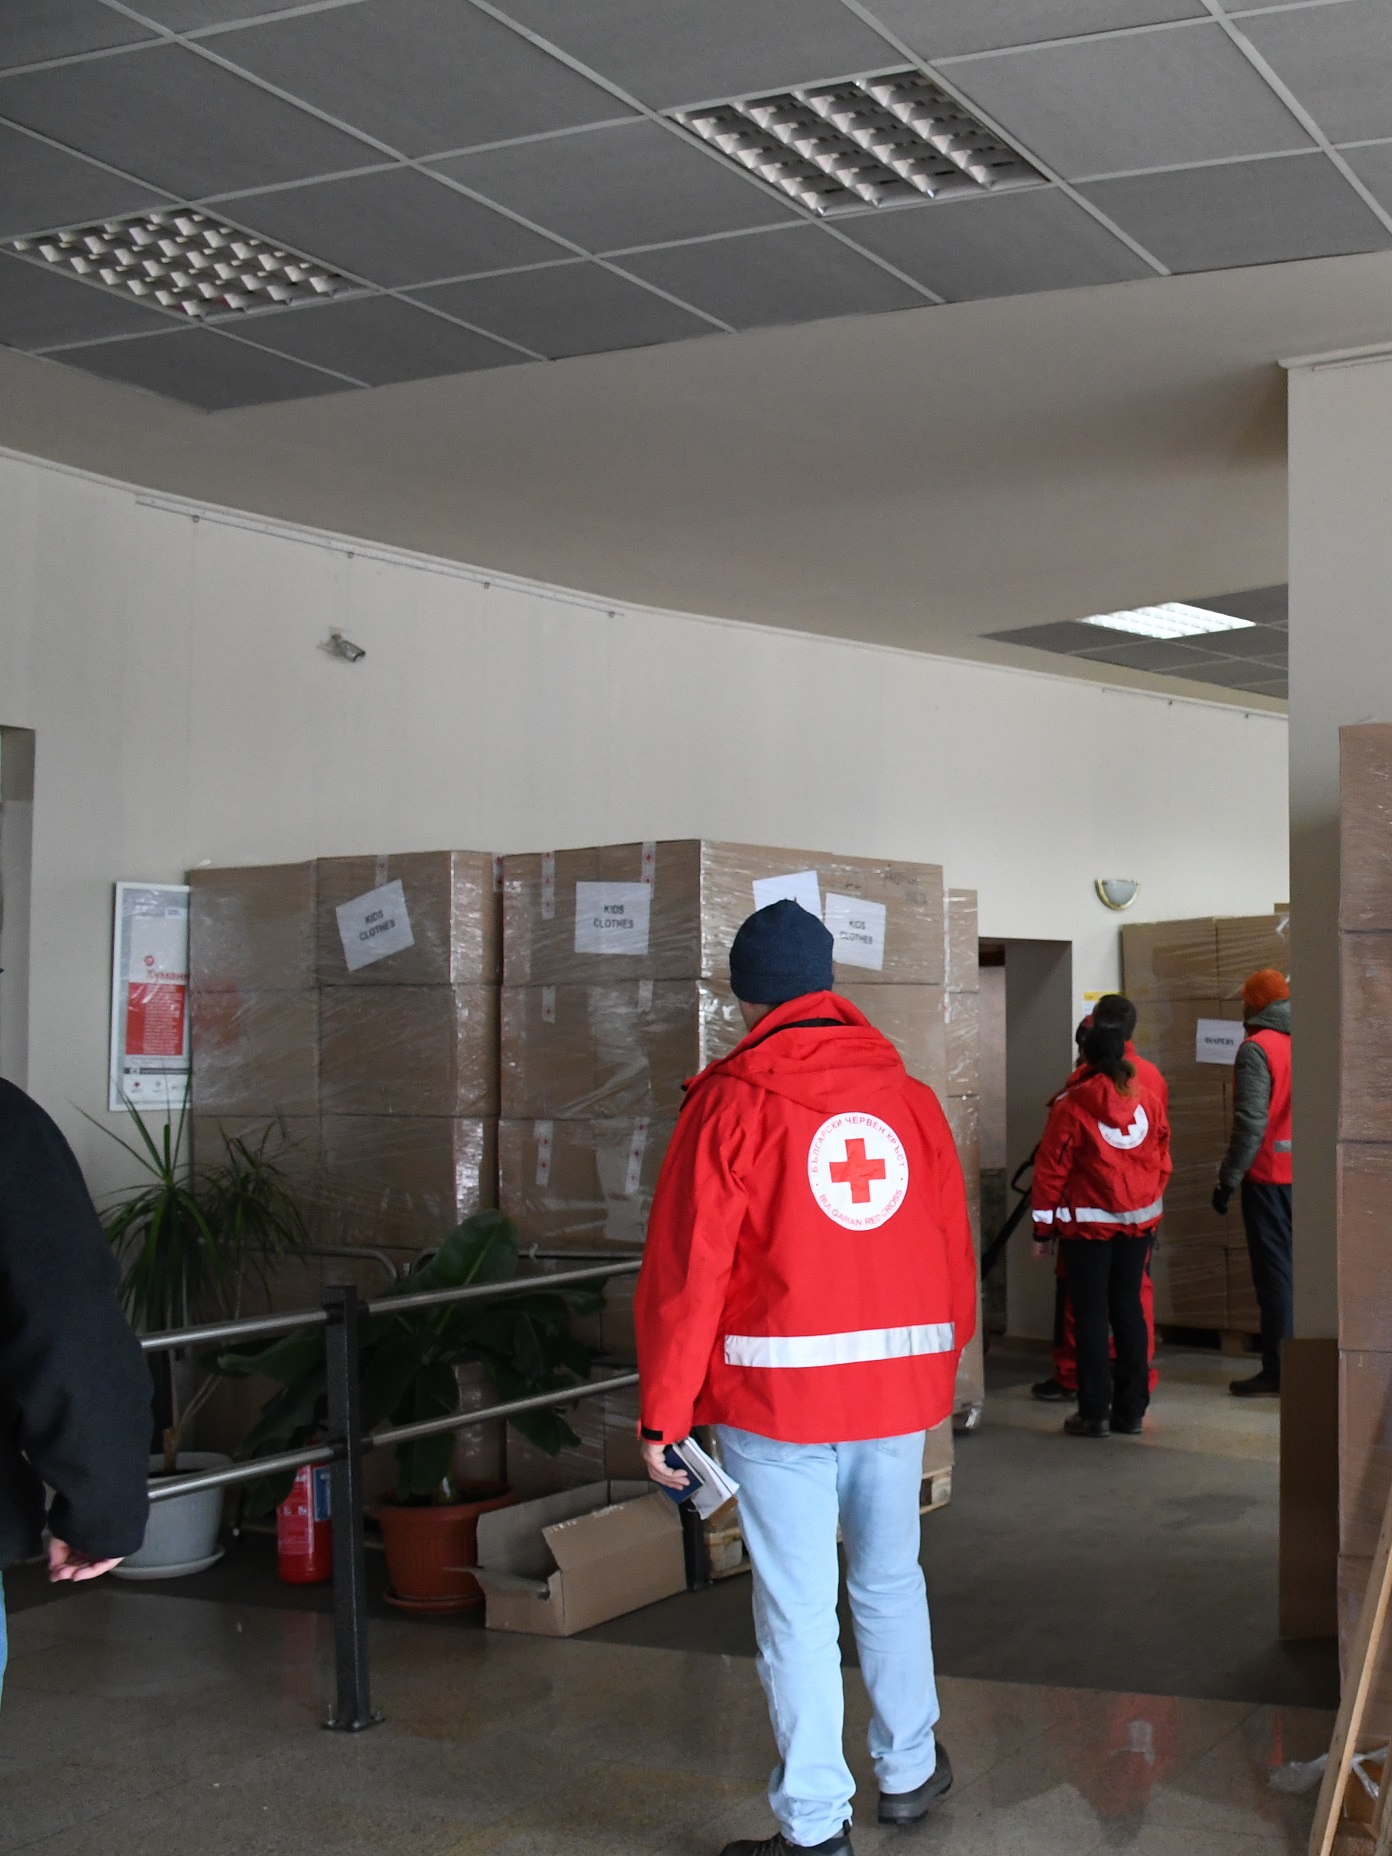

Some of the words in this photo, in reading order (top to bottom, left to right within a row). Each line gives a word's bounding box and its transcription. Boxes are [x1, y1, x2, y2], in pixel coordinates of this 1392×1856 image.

[603, 904, 625, 915] KIDS
[358, 919, 396, 942] CLOTHES
[592, 918, 635, 930] CLOTHES
[844, 1116, 886, 1134] ЧЕРВЕН
[886, 1133, 905, 1168] КРЪСТ
[819, 1194, 862, 1226] BULGARIAN
[865, 1214, 881, 1226] RED
[881, 1189, 902, 1217] CROSS
